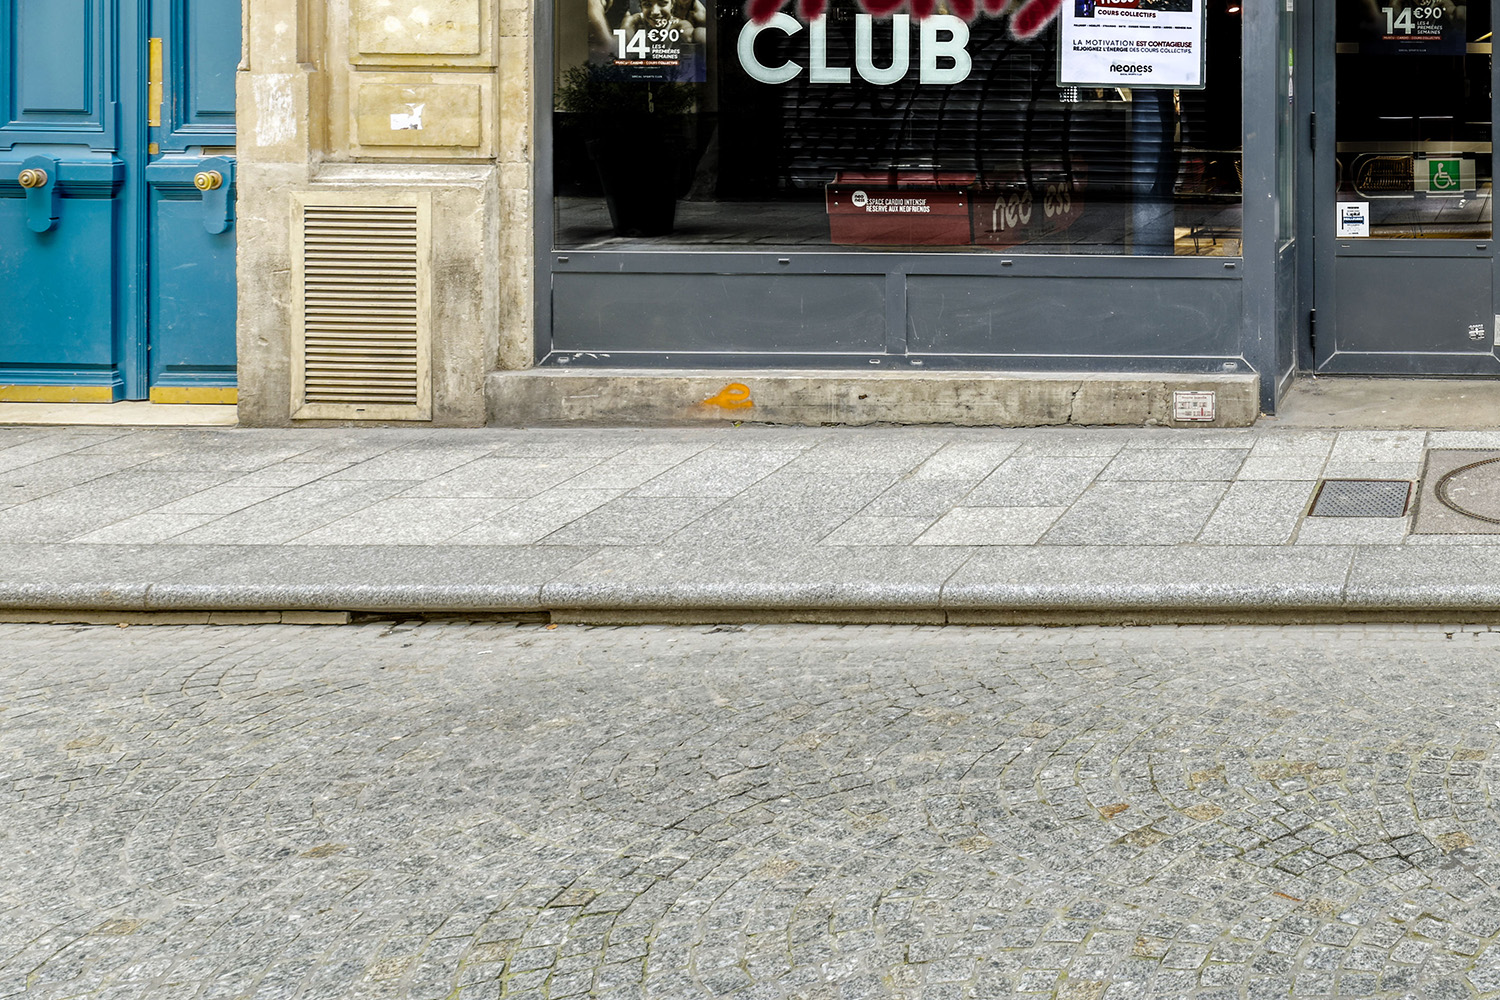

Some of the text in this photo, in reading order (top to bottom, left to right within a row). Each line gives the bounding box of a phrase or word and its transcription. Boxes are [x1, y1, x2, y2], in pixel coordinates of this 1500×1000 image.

[1120, 10, 1157, 18] COLLECTIFS
[1085, 39, 1135, 47] MOTIVATION
[737, 13, 973, 85] CLUB
[1109, 64, 1153, 73] neoness
[866, 198, 927, 206] ESPACE CARDIO INTENSIF
[888, 205, 899, 213] AUX
[899, 205, 931, 213] NEOFRIENDS
